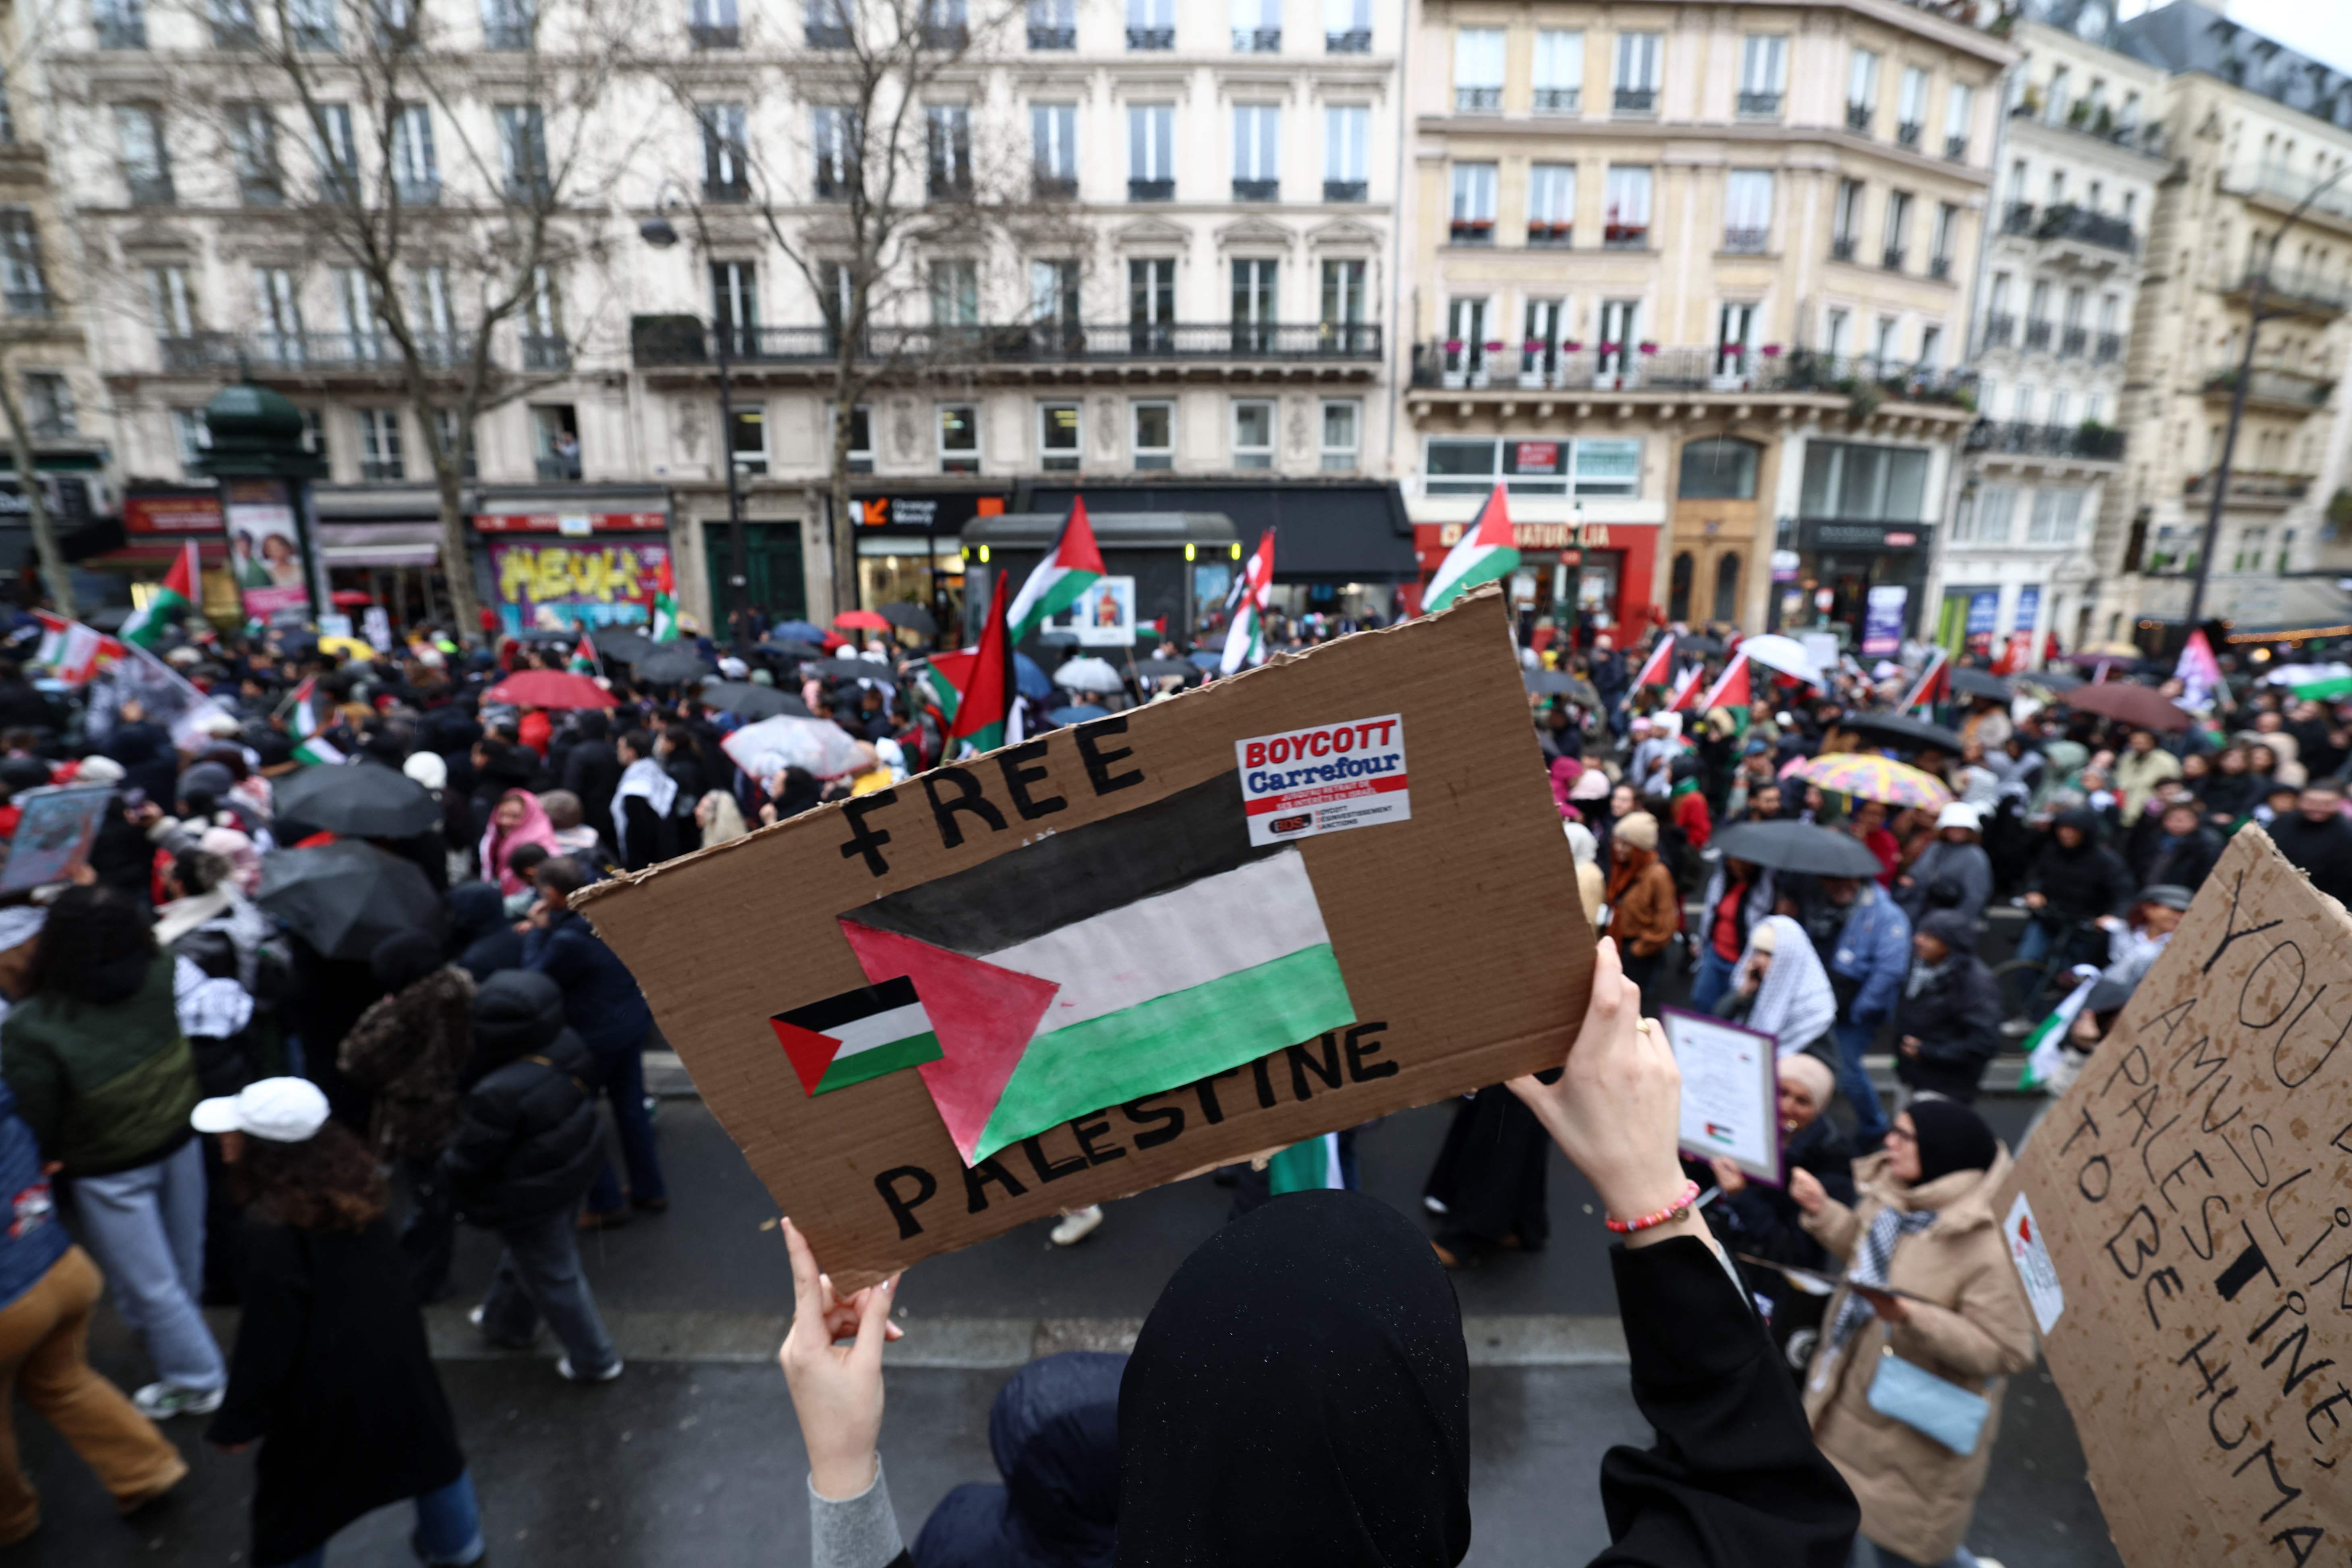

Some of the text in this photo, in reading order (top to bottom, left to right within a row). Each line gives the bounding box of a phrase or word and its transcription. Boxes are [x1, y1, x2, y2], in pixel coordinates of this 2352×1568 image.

[840, 716, 1145, 877] FREE
[1246, 719, 1396, 768] BOYCOTT
[1248, 753, 1400, 794] Carrefour
[2202, 869, 2352, 1088] YOU
[874, 1022, 1399, 1241] PALESTINE
[2060, 1106, 2352, 1568] TO BE HUMA
